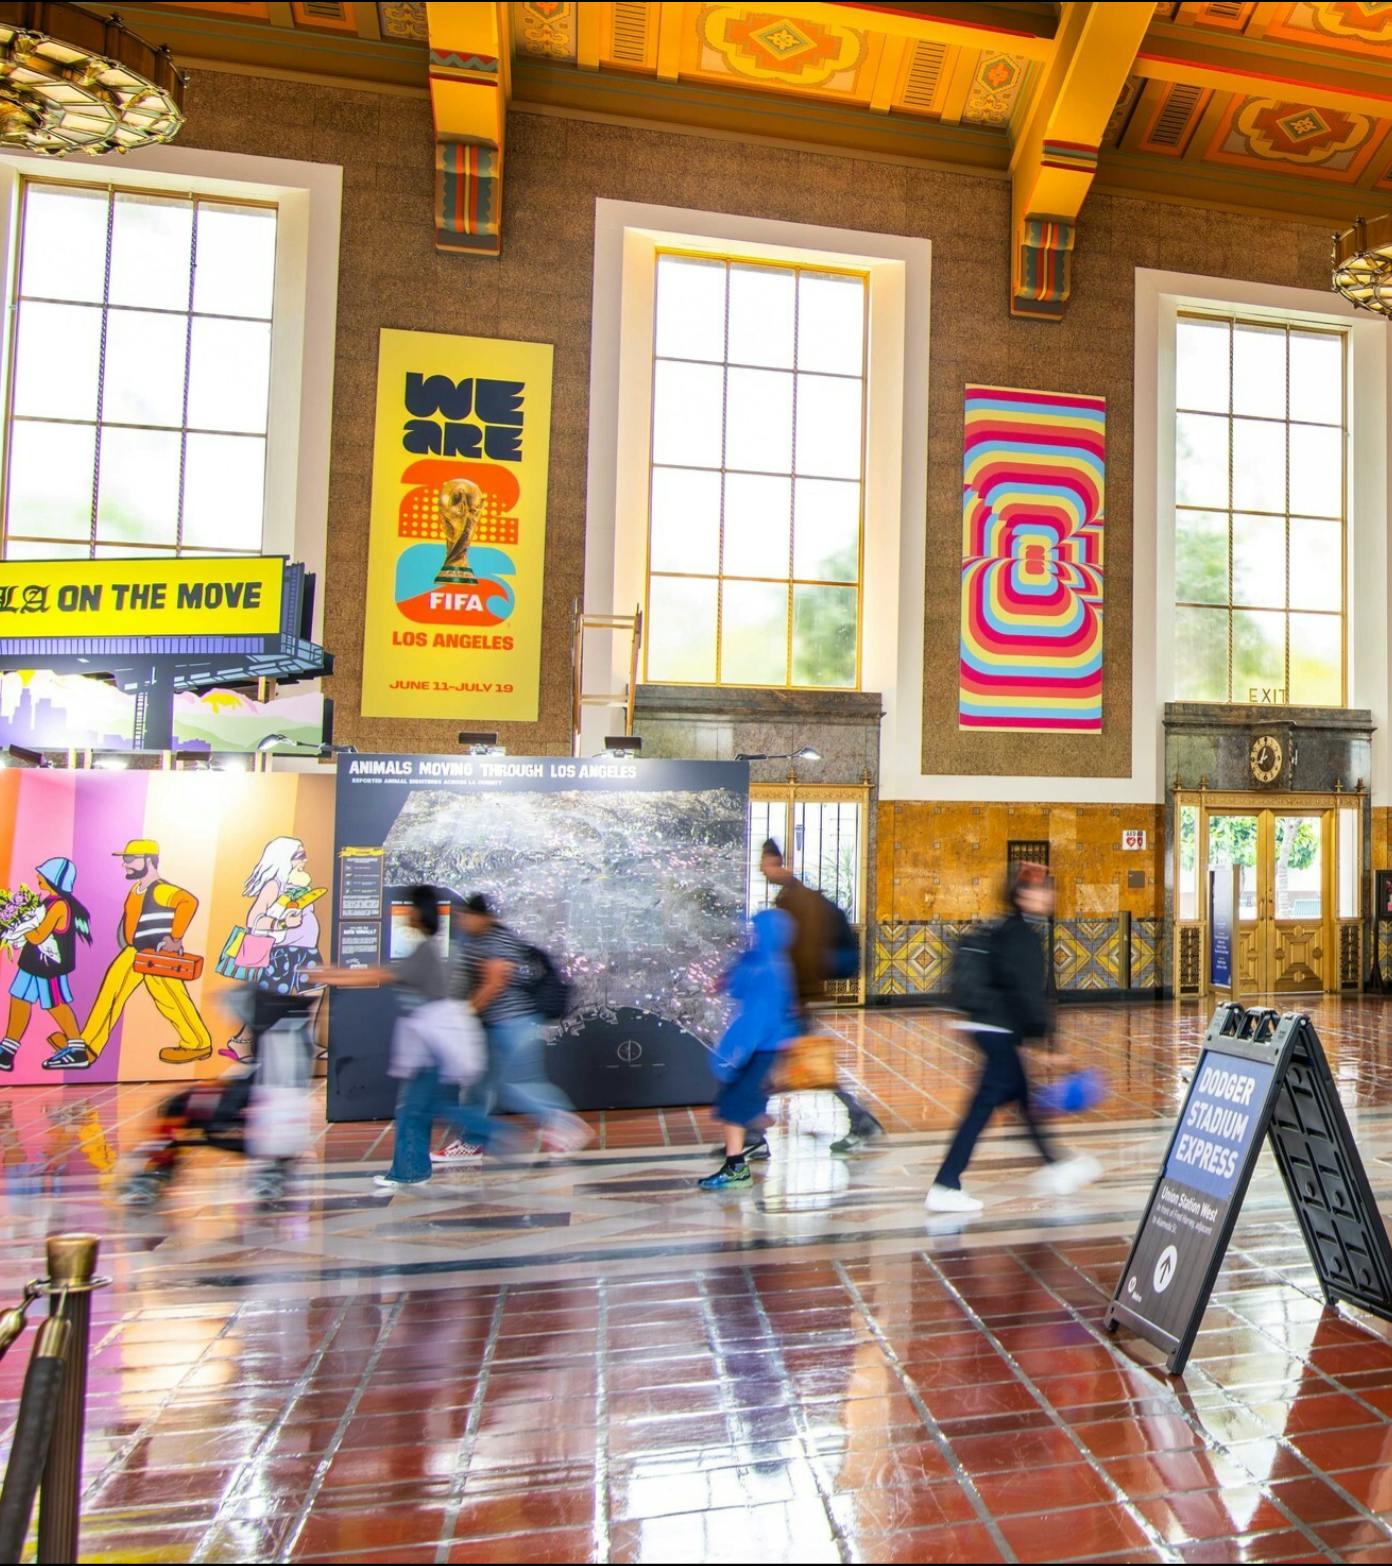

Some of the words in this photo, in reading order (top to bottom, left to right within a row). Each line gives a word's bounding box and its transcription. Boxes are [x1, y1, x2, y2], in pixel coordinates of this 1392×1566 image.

[405, 372, 525, 426] WE
[403, 419, 523, 462] ARE
[0, 585, 50, 614] LA
[57, 585, 103, 612] ON
[111, 583, 167, 611] THE
[177, 582, 262, 609] MOVE
[430, 592, 484, 612] FIFA
[392, 631, 427, 646] LOS
[433, 633, 514, 650] ANGELES
[389, 681, 429, 689] JUNE
[495, 684, 513, 693] 19
[1249, 688, 1286, 704] EXIT
[349, 760, 412, 775] ANIMALS
[419, 762, 472, 776] MOVING
[479, 763, 543, 778] THROUGH
[551, 765, 576, 778] LOS
[578, 765, 637, 779] ANGELES
[1198, 1067, 1255, 1106] DODGER
[1186, 1101, 1249, 1143] STADIUM
[1176, 1133, 1239, 1179] EXPRESS
[1161, 1185, 1180, 1205] Union
[1178, 1193, 1201, 1216] Station
[1200, 1201, 1218, 1223] West
